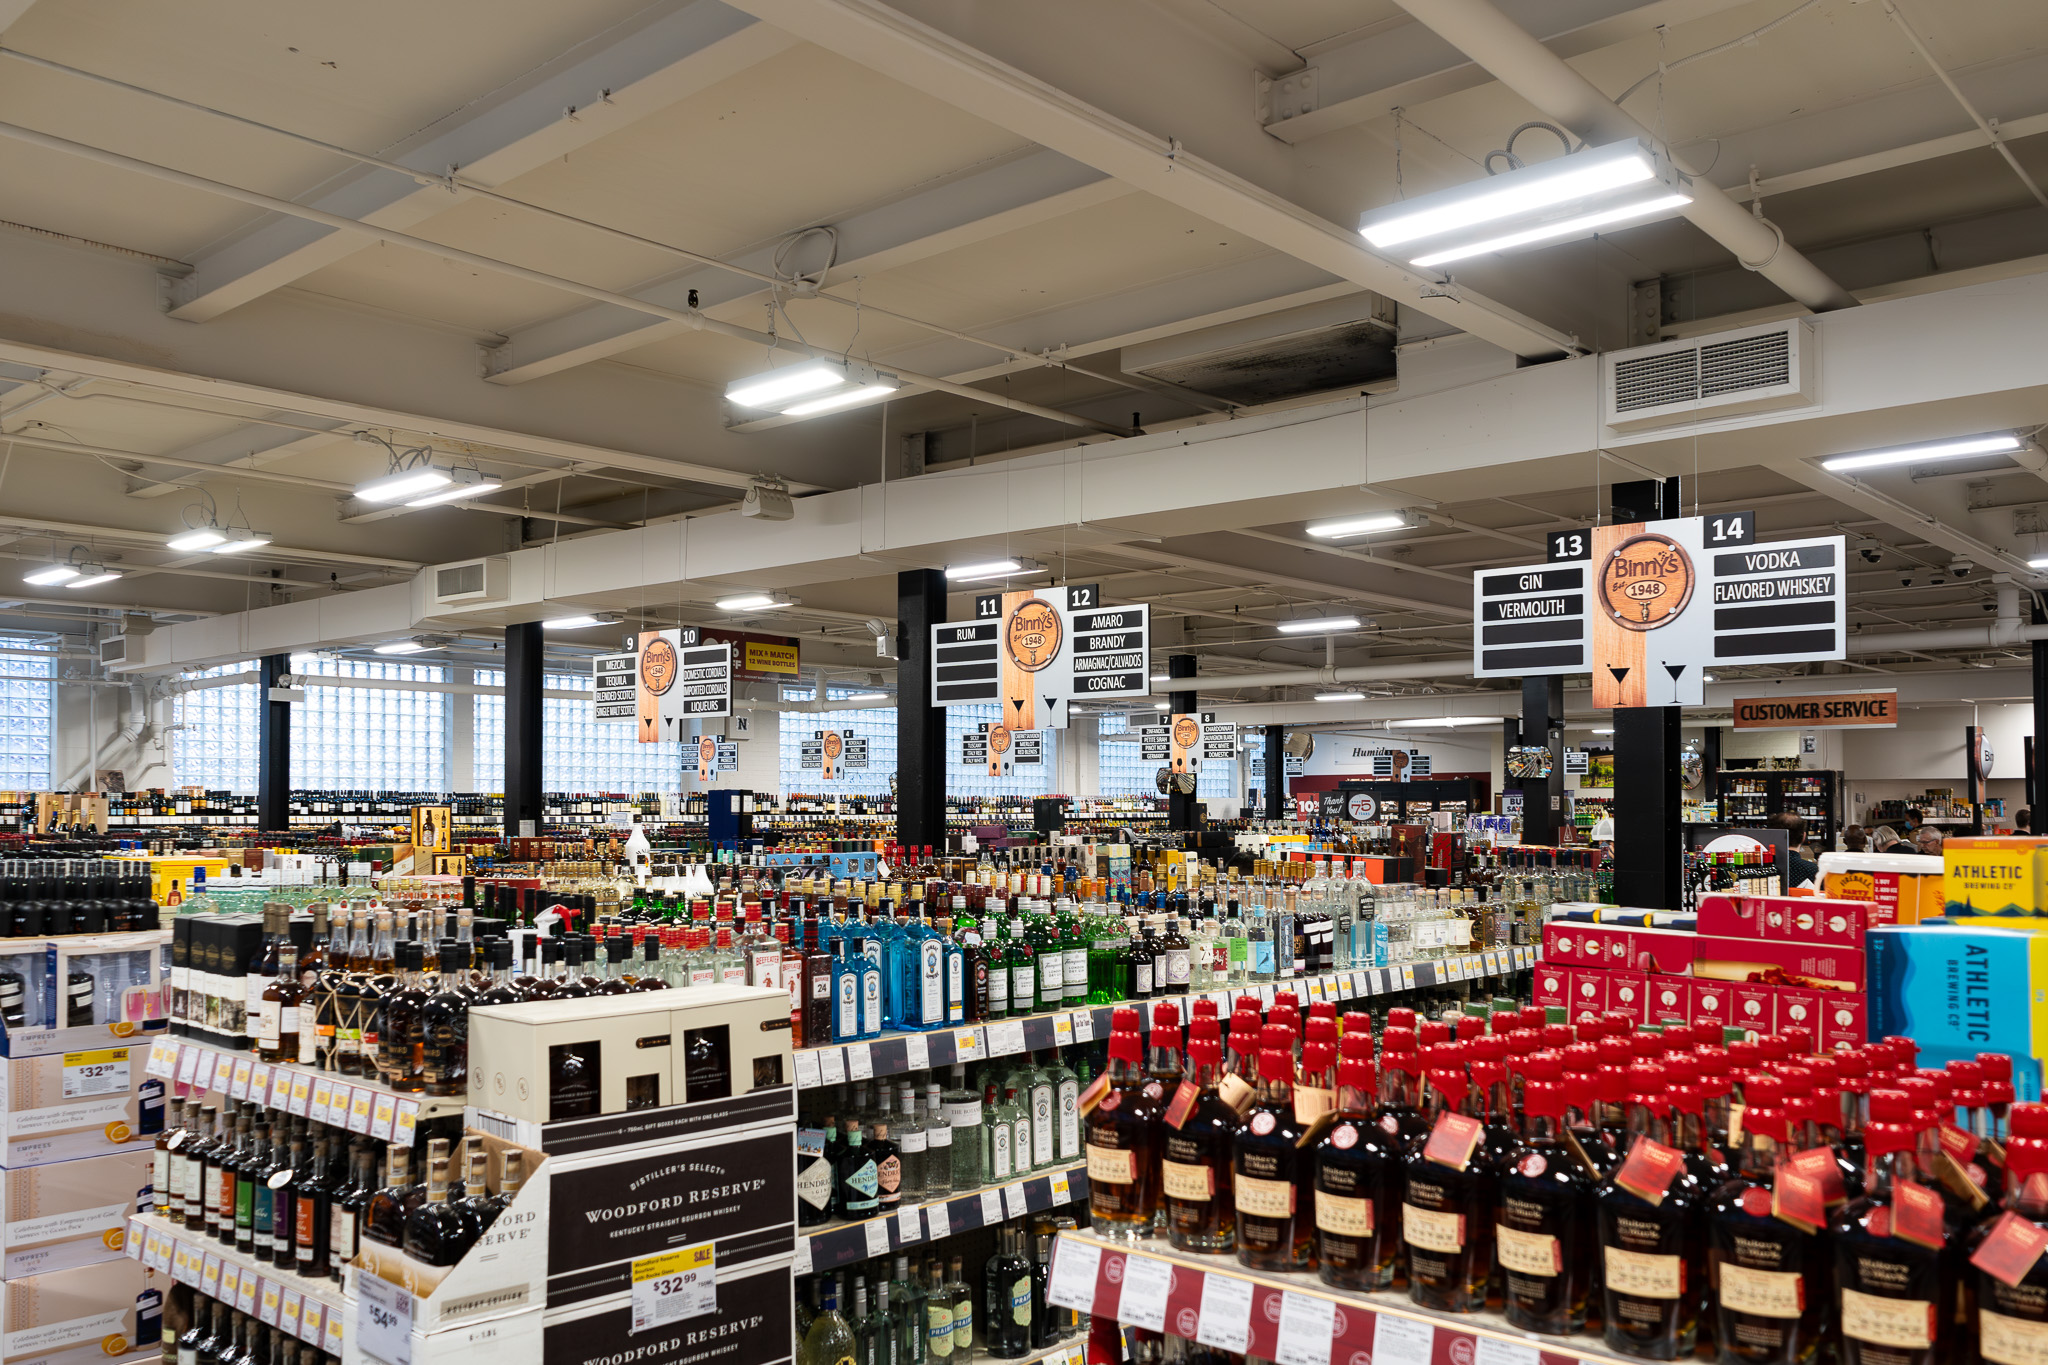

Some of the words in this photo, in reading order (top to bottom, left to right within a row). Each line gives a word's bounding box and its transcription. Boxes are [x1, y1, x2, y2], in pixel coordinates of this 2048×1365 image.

[1712, 517, 1744, 541] 14
[1555, 535, 1583, 557] 13
[1615, 551, 1679, 578] Binny's
[1745, 551, 1801, 571] VODKA
[1520, 574, 1543, 590] GIN
[1630, 583, 1660, 596] 1948
[1715, 581, 1775, 601] FLAVORED
[1777, 576, 1831, 596] WHISKEY
[1072, 589, 1090, 607] 12
[980, 599, 997, 616] 11
[1499, 599, 1565, 618] VERMOUTH
[1015, 612, 1053, 632] Binny's
[1091, 614, 1123, 629] AMARO
[683, 630, 696, 644] 10
[957, 628, 976, 641] RUM
[1024, 635, 1042, 645] 1948
[626, 637, 634, 651] 9
[1089, 635, 1126, 650] BRANDY
[749, 649, 763, 657] MIX
[770, 651, 795, 660] MATCH
[605, 659, 626, 670] MEZCAL
[1074, 654, 1142, 671] ARMAGNAC/CALVADOS
[605, 675, 627, 686] TEQUILA
[1088, 675, 1126, 691] COGNAC
[691, 700, 719, 712] LIQUEURS
[1740, 702, 1820, 721] CUSTOMER
[1824, 700, 1888, 718] SERVICE
[1204, 714, 1210, 722] 8
[1352, 747, 1385, 757] Humid
[1324, 795, 1344, 805] Thank
[1326, 805, 1342, 814] You!
[1953, 865, 2023, 879] ATHLETIC
[756, 955, 780, 967] BEEFEATER
[693, 972, 714, 982] BEEFEATER
[724, 969, 745, 979] BEEFEATER
[817, 983, 827, 993] 24
[1946, 959, 1959, 1010] BREWING
[1965, 944, 1990, 1042] ATHLETIC
[630, 1163, 686, 1191] DISTILLER'S
[585, 1195, 684, 1224] WOODFORD
[609, 1225, 645, 1238] KENTUCKY
[647, 1218, 680, 1231] STRAIGHT
[681, 1211, 712, 1224] BOURBON
[713, 1204, 741, 1218] WHISKEY
[694, 1248, 710, 1263] SALE
[711, 1343, 738, 1358] WHISKEY
